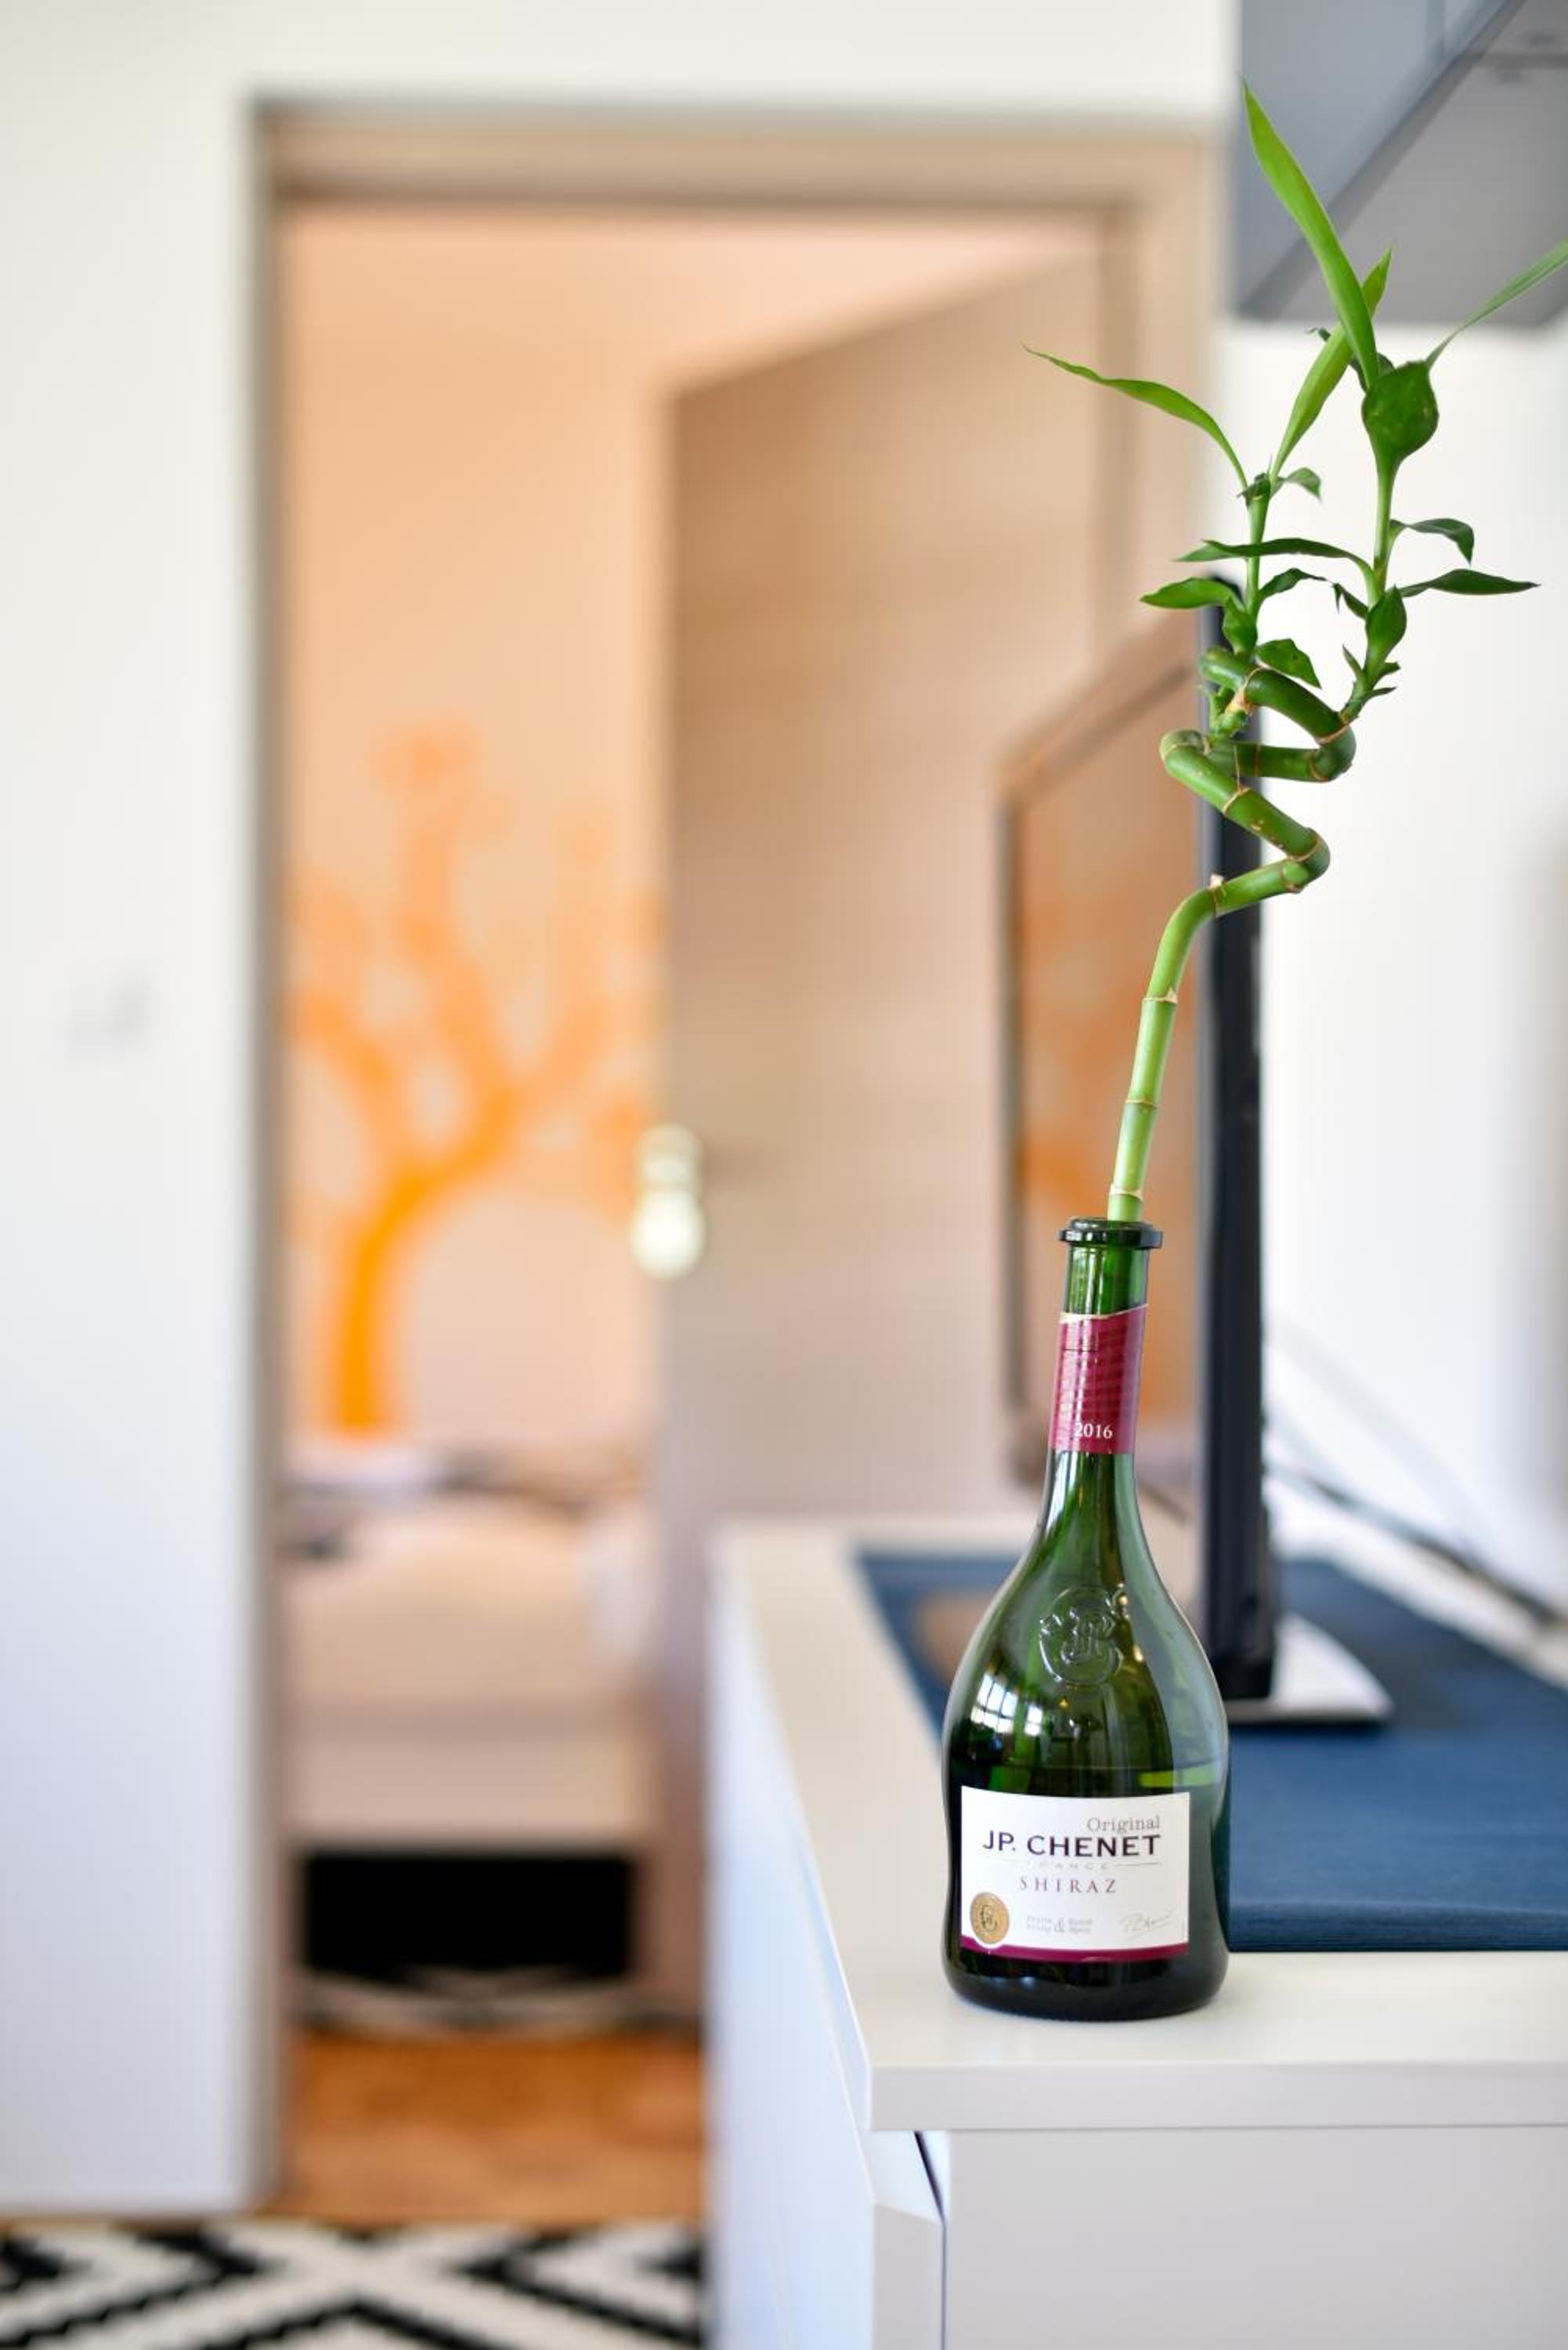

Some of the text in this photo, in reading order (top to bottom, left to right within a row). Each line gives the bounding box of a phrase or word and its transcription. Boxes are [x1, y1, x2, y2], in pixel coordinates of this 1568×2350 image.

[1074, 1423, 1114, 1439] 2016
[1086, 1815, 1161, 1835] Original
[982, 1829, 1162, 1857] JP. CHENET
[1019, 1877, 1118, 1894] SHIRAZ
